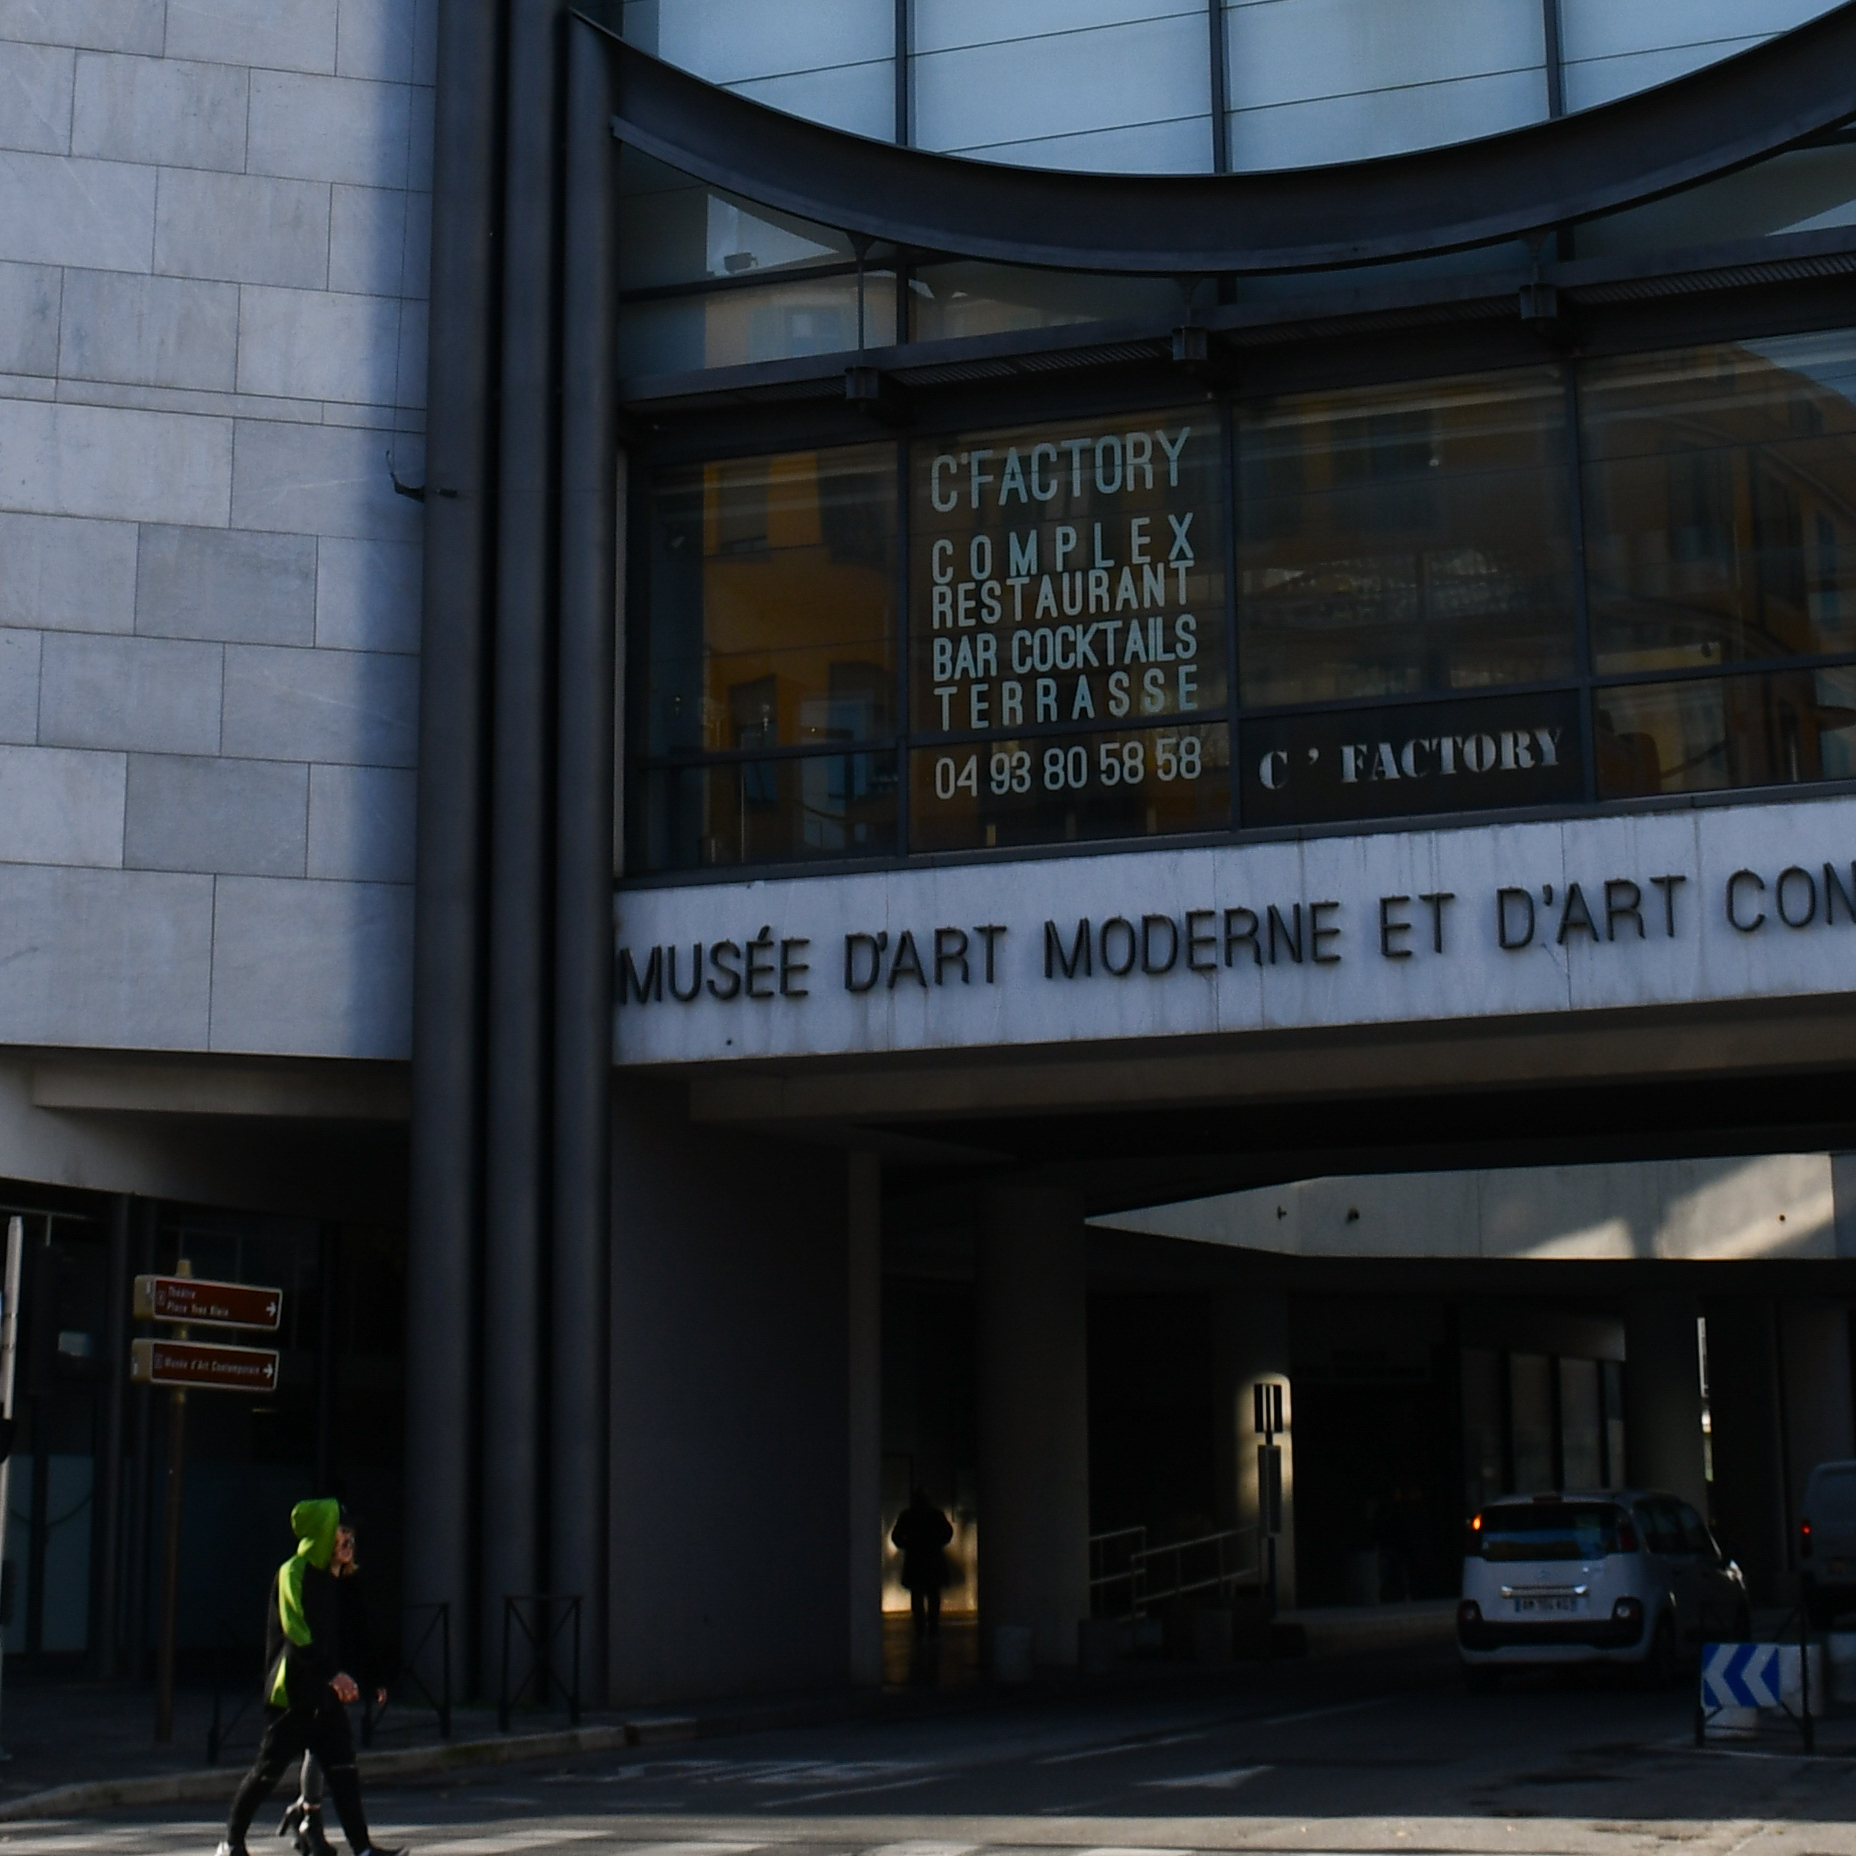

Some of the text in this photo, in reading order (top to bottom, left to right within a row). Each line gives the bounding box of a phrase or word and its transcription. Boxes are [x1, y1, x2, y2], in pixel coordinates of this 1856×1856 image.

[932, 512, 1195, 585] COMPLEX
[932, 559, 1195, 630] RESTAURANT
[933, 614, 1198, 682] BAR COCKTAILS
[934, 664, 1198, 731] TERRASSE
[935, 736, 1203, 800] 04 93 80 58 58
[1341, 726, 1564, 784] FACTORY
[618, 923, 811, 1006] MUSÉE
[844, 924, 1008, 993] D'ART
[1043, 901, 1342, 981] MODERNE
[1381, 893, 1455, 960] ET
[1497, 875, 1686, 949] D'ART
